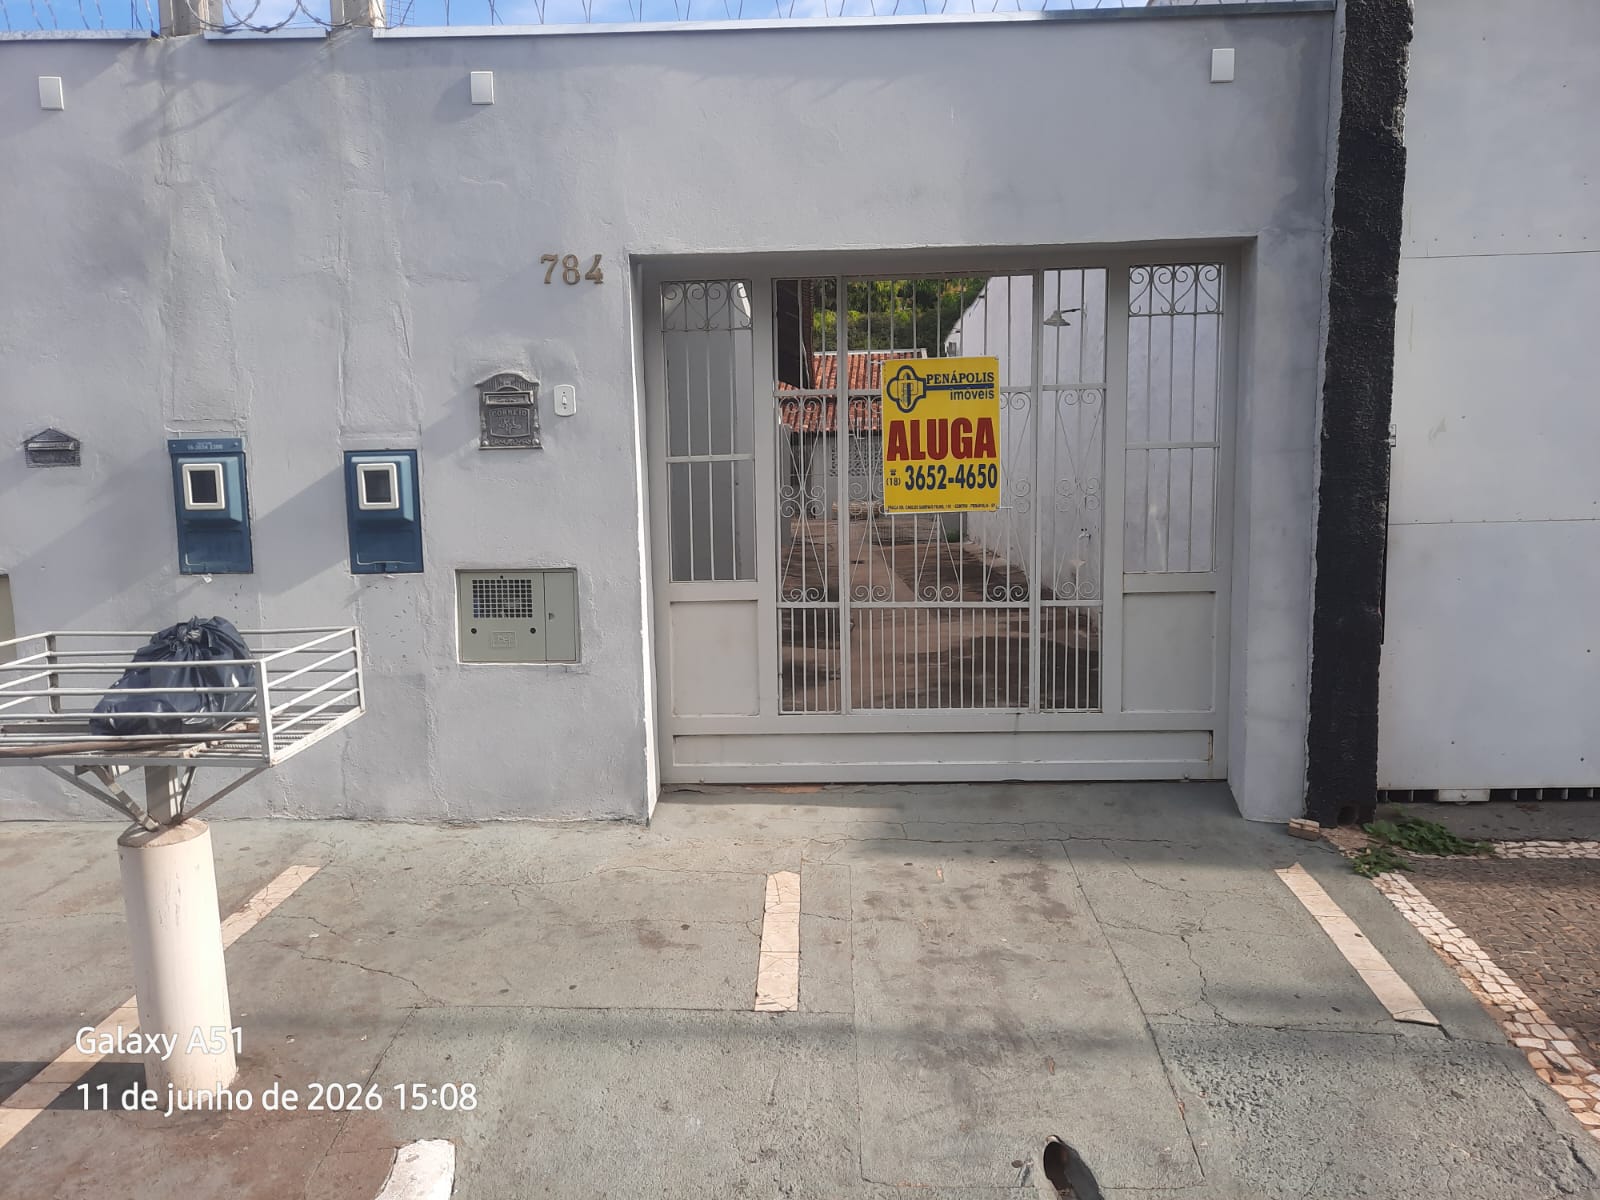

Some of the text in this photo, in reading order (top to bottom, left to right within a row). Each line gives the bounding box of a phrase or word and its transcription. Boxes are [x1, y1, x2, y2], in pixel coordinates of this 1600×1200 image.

[540, 253, 604, 285] 784
[926, 370, 994, 384] PENÁPOLIS
[950, 389, 994, 400] imóveis
[886, 417, 997, 461] ALUGA
[886, 463, 998, 490] (18) 3652-4650
